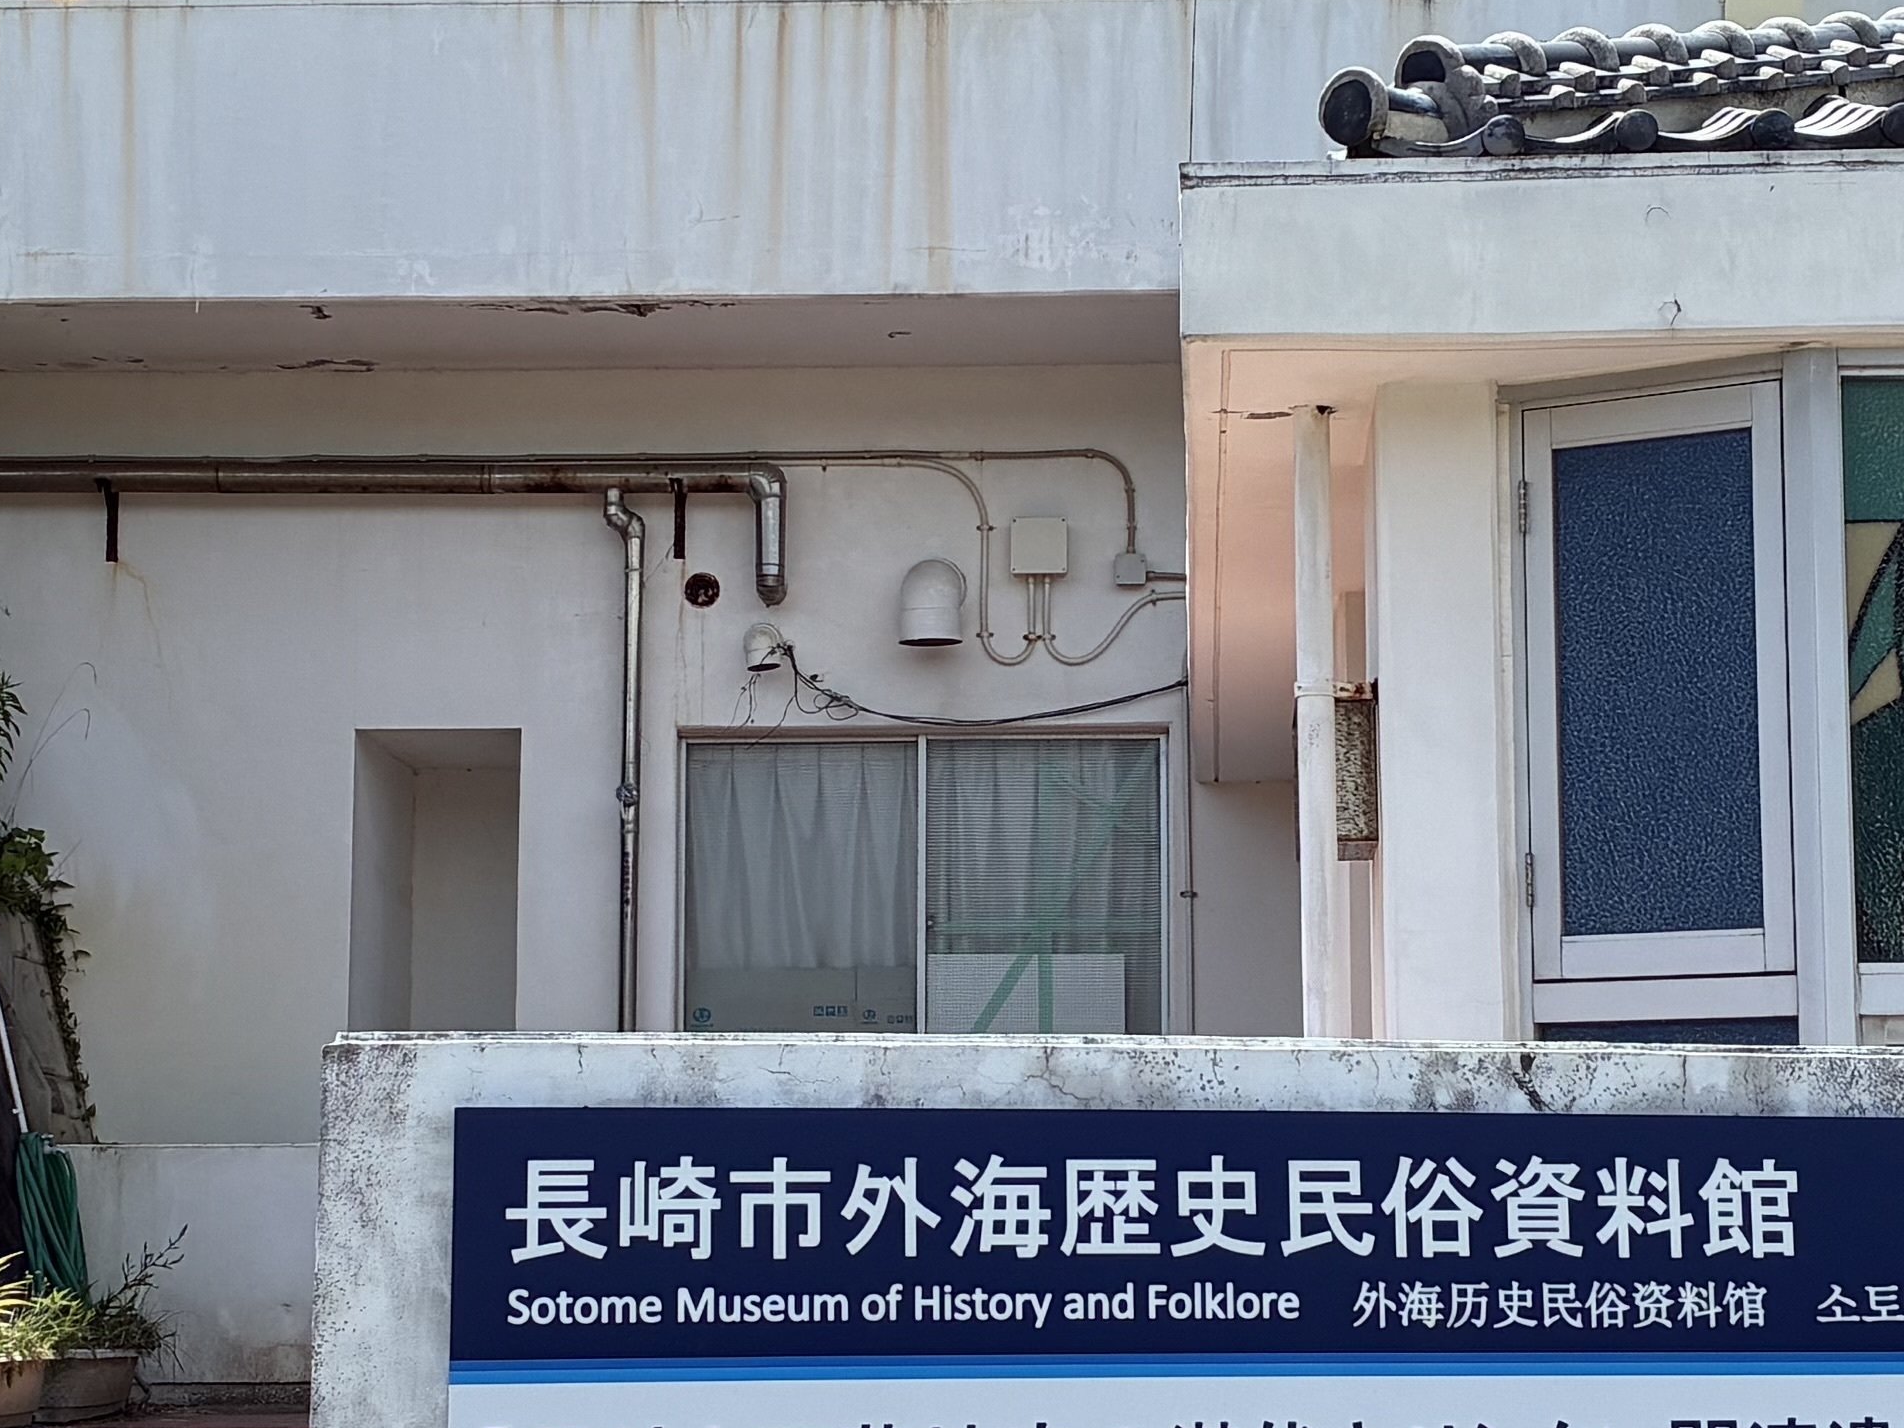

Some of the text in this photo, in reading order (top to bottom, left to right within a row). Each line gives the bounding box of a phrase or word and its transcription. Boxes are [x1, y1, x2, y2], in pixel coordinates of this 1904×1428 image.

[505, 1154, 1798, 1264] 長崎市外海歴史民俗資料館
[507, 1280, 1300, 1329] Sotome Museum of History and Folklore
[1352, 1280, 1768, 1329] 外海历史民俗资料馆
